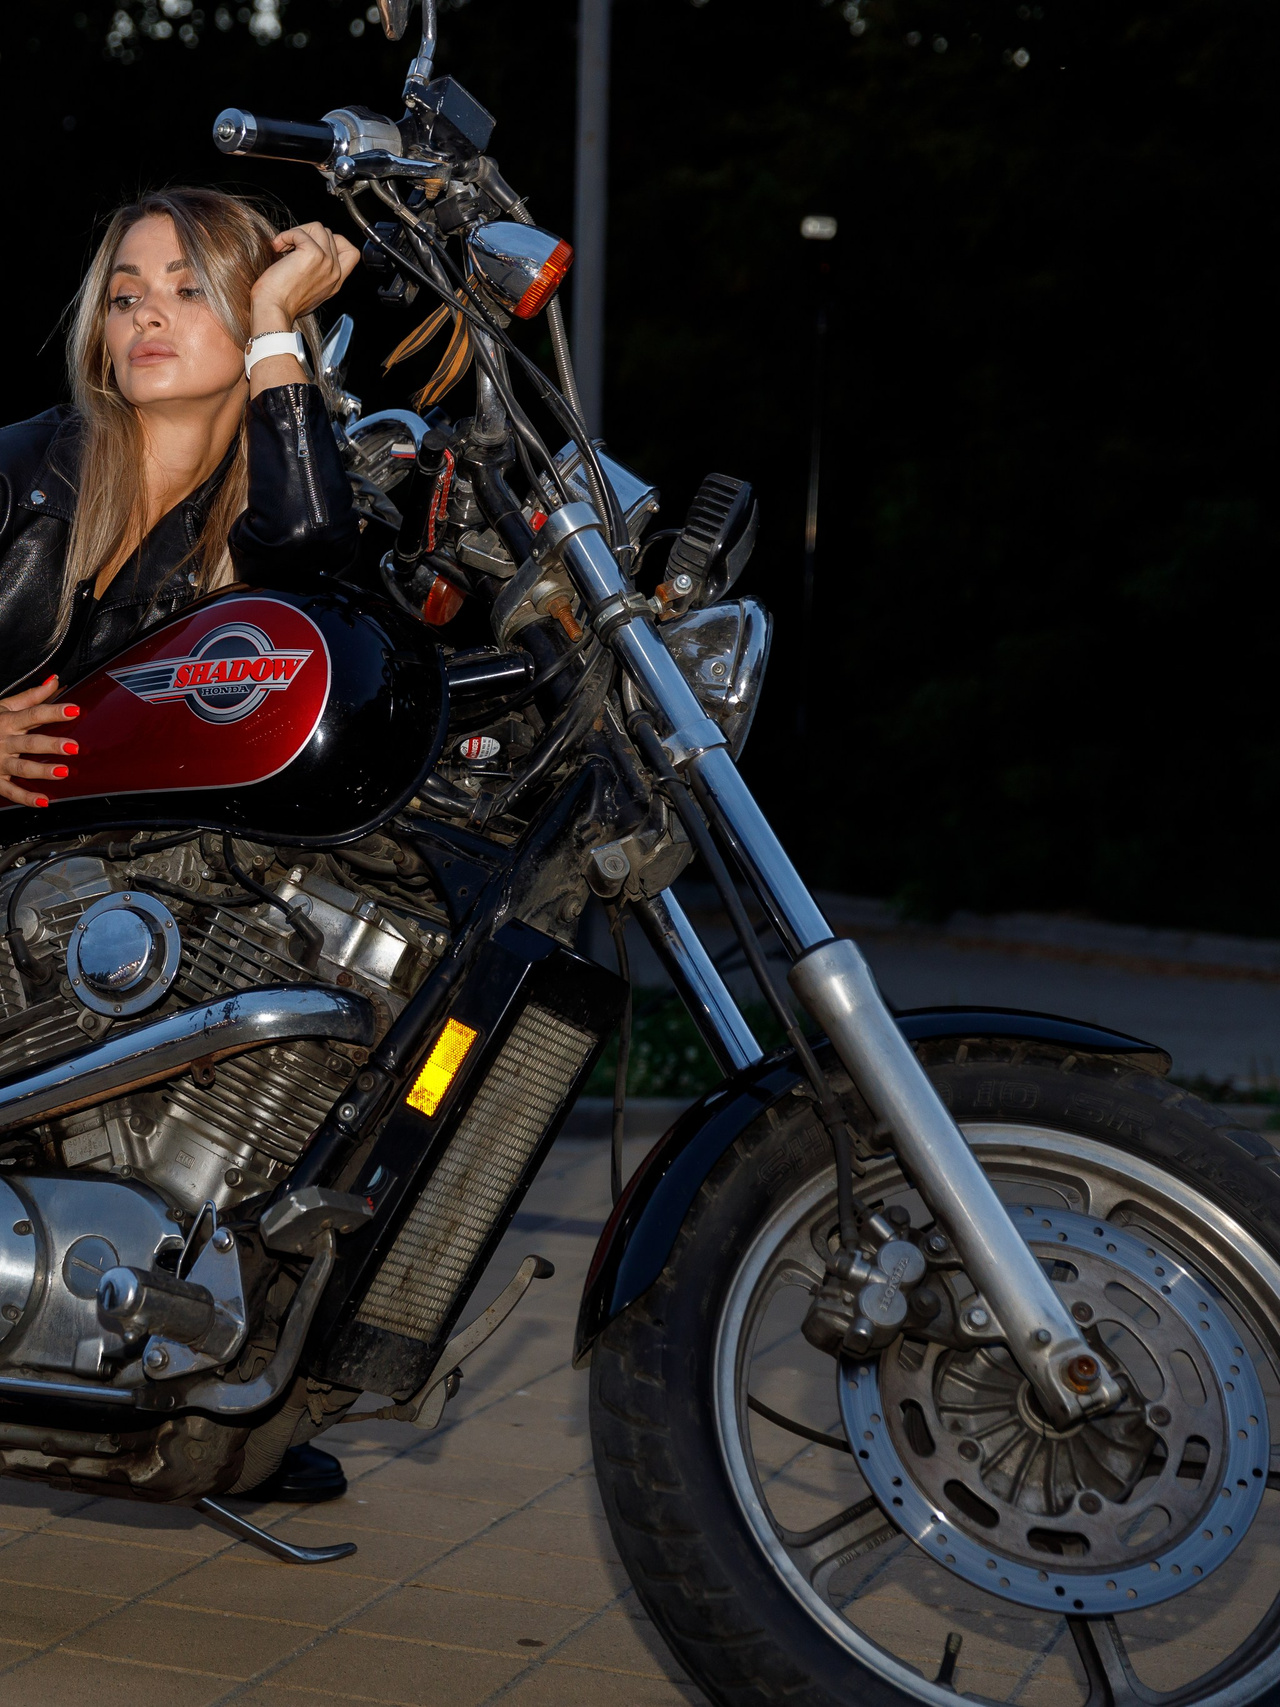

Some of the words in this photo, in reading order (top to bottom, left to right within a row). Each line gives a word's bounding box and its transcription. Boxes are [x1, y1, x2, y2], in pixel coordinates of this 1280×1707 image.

[174, 657, 304, 688] SHADOW
[202, 684, 249, 696] HONDA
[879, 1256, 910, 1313] HONDA
